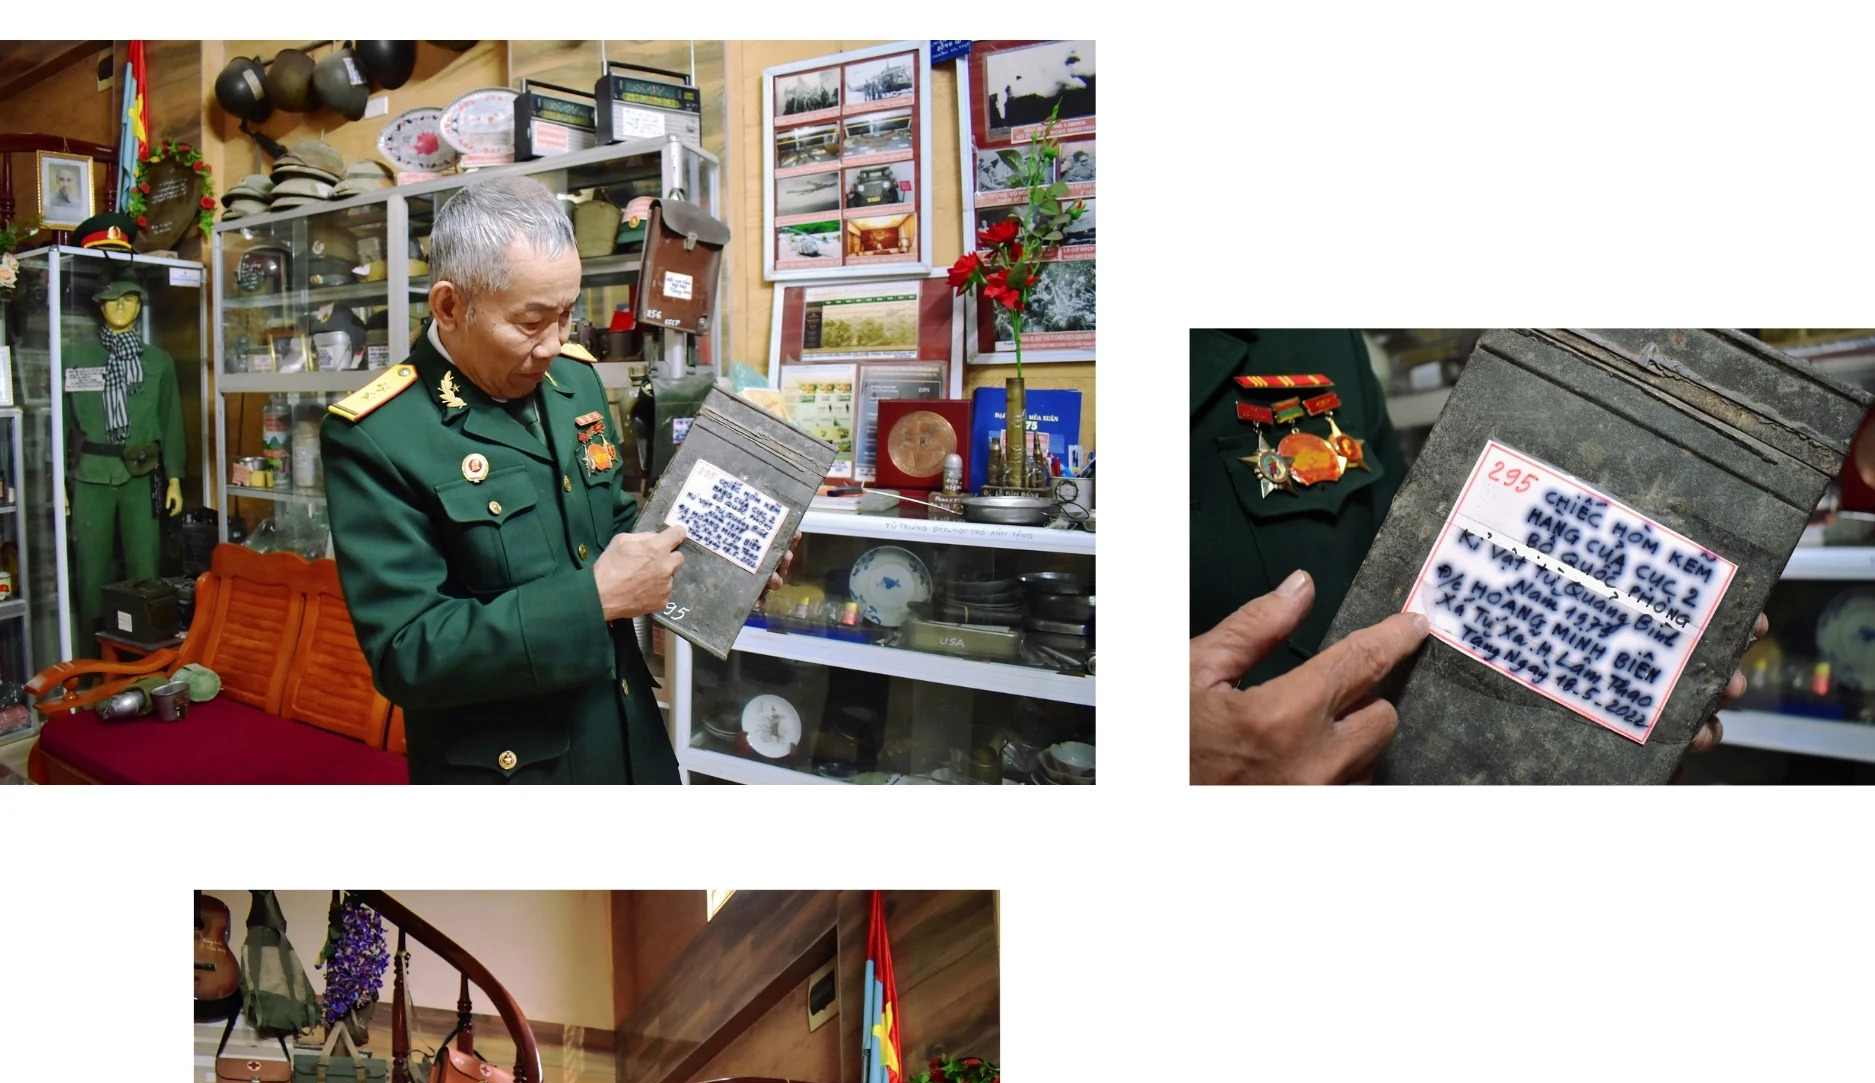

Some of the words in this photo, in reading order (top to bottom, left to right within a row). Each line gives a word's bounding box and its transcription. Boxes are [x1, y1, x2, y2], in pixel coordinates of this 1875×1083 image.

[647, 309, 662, 319] 256
[698, 467, 718, 480] 295
[1488, 461, 1539, 493] 295
[770, 516, 776, 525] 2
[1545, 491, 1607, 528] CHIẾC
[1612, 522, 1659, 554] HÒM
[1669, 551, 1717, 583] KẼM
[1526, 532, 1556, 559] BỘ
[1561, 552, 1621, 588] QUỐC
[1628, 585, 1690, 628] PHÒNG
[1527, 507, 1579, 545] HÀNG
[1586, 539, 1626, 570] CỦA
[1636, 565, 1677, 597] CỤC
[1682, 588, 1696, 608] 2
[940, 637, 965, 648] USA
[1436, 592, 1475, 618] Xã
[1555, 651, 1602, 684] Lâm
[1609, 674, 1653, 708] Thao
[1471, 580, 1546, 630] HOÀNG
[1551, 622, 1606, 660] MINH
[1613, 650, 1662, 685] BIÊN
[1634, 614, 1681, 647] Bình
[1461, 624, 1500, 662] Tặng
[1503, 650, 1549, 684] Ngày
